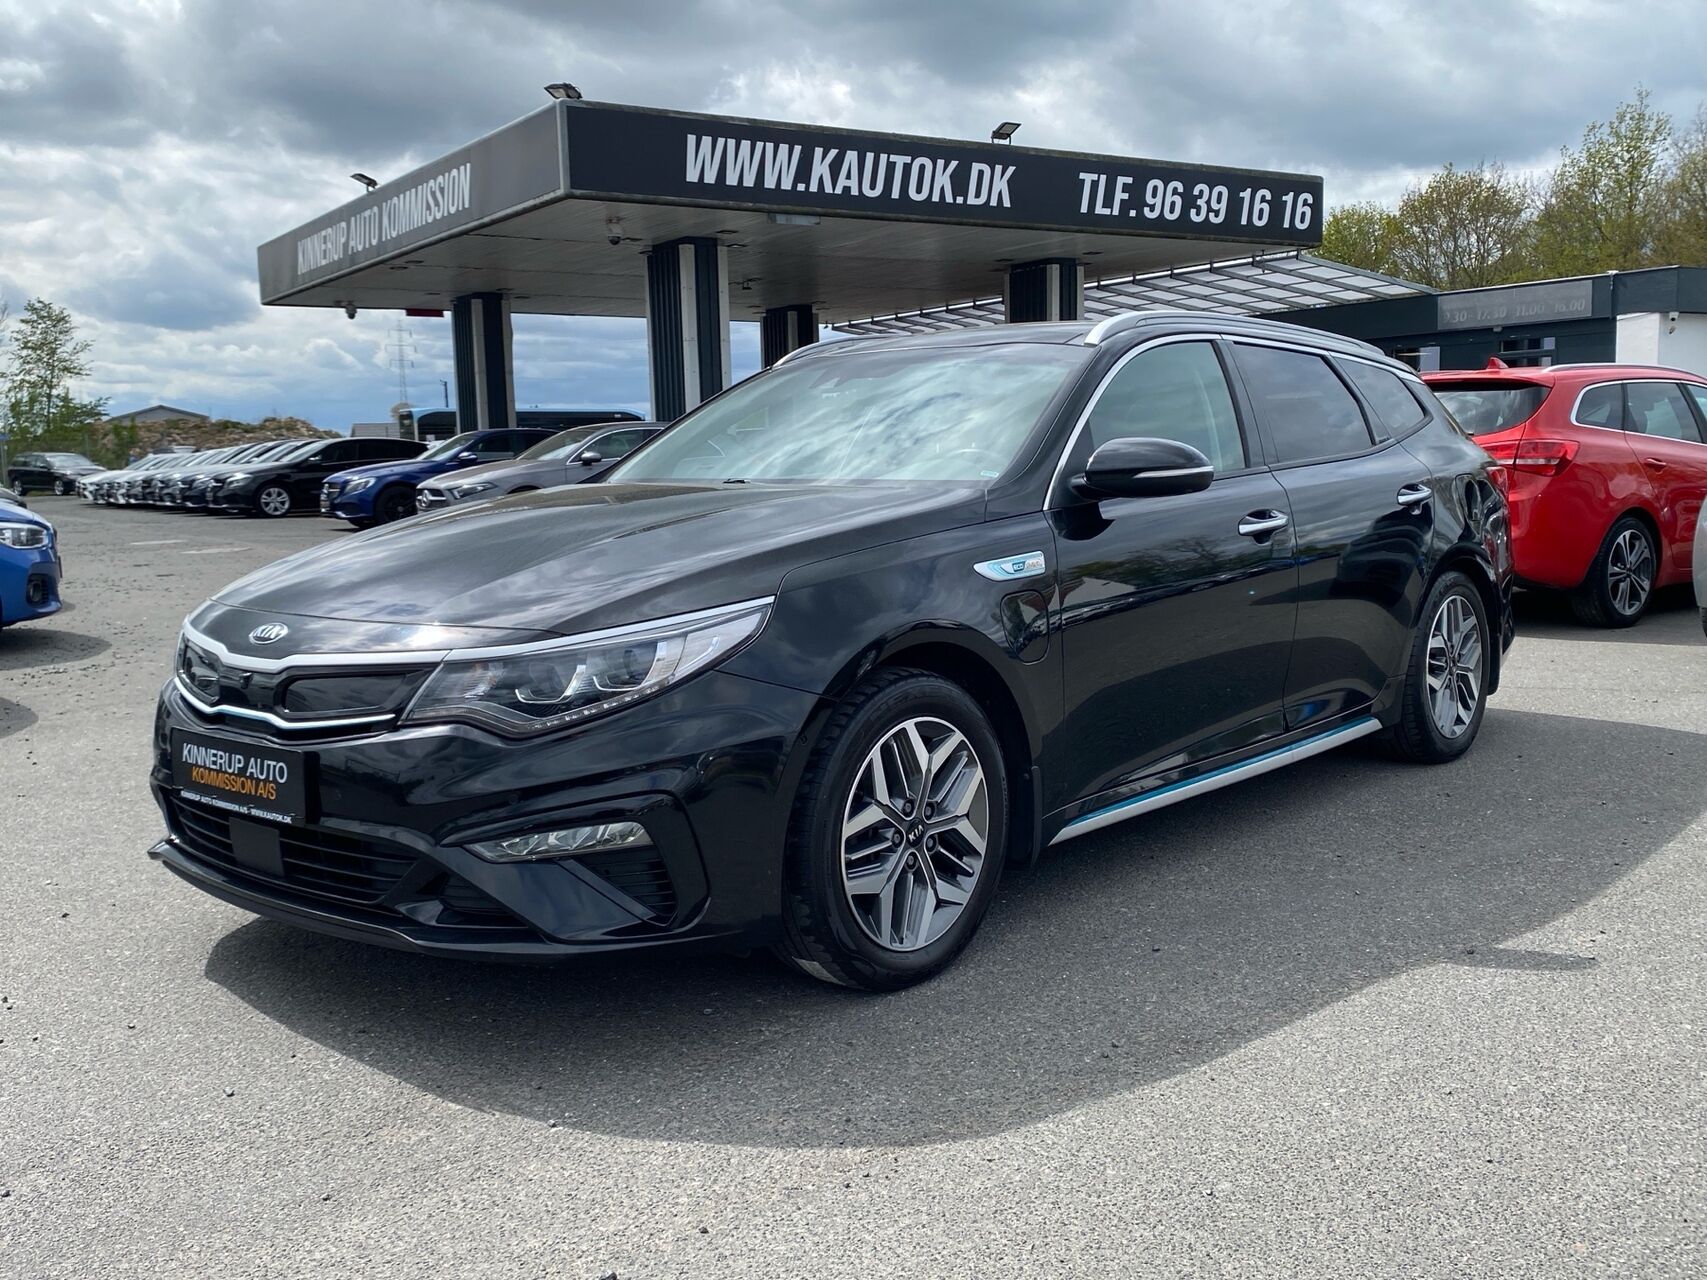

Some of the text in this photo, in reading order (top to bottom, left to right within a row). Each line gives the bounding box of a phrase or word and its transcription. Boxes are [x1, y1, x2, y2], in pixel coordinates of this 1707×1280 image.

[685, 133, 1017, 208] WWW.KAUTOK.DK
[297, 162, 471, 276] KINNERUP AUTO KOMMISSION
[1078, 172, 1314, 230] TLF. 96 39 16 16
[182, 742, 288, 784] KINNERUP AUTO
[192, 765, 277, 800] KOMMISSION A/S
[908, 824, 924, 843] KIA
